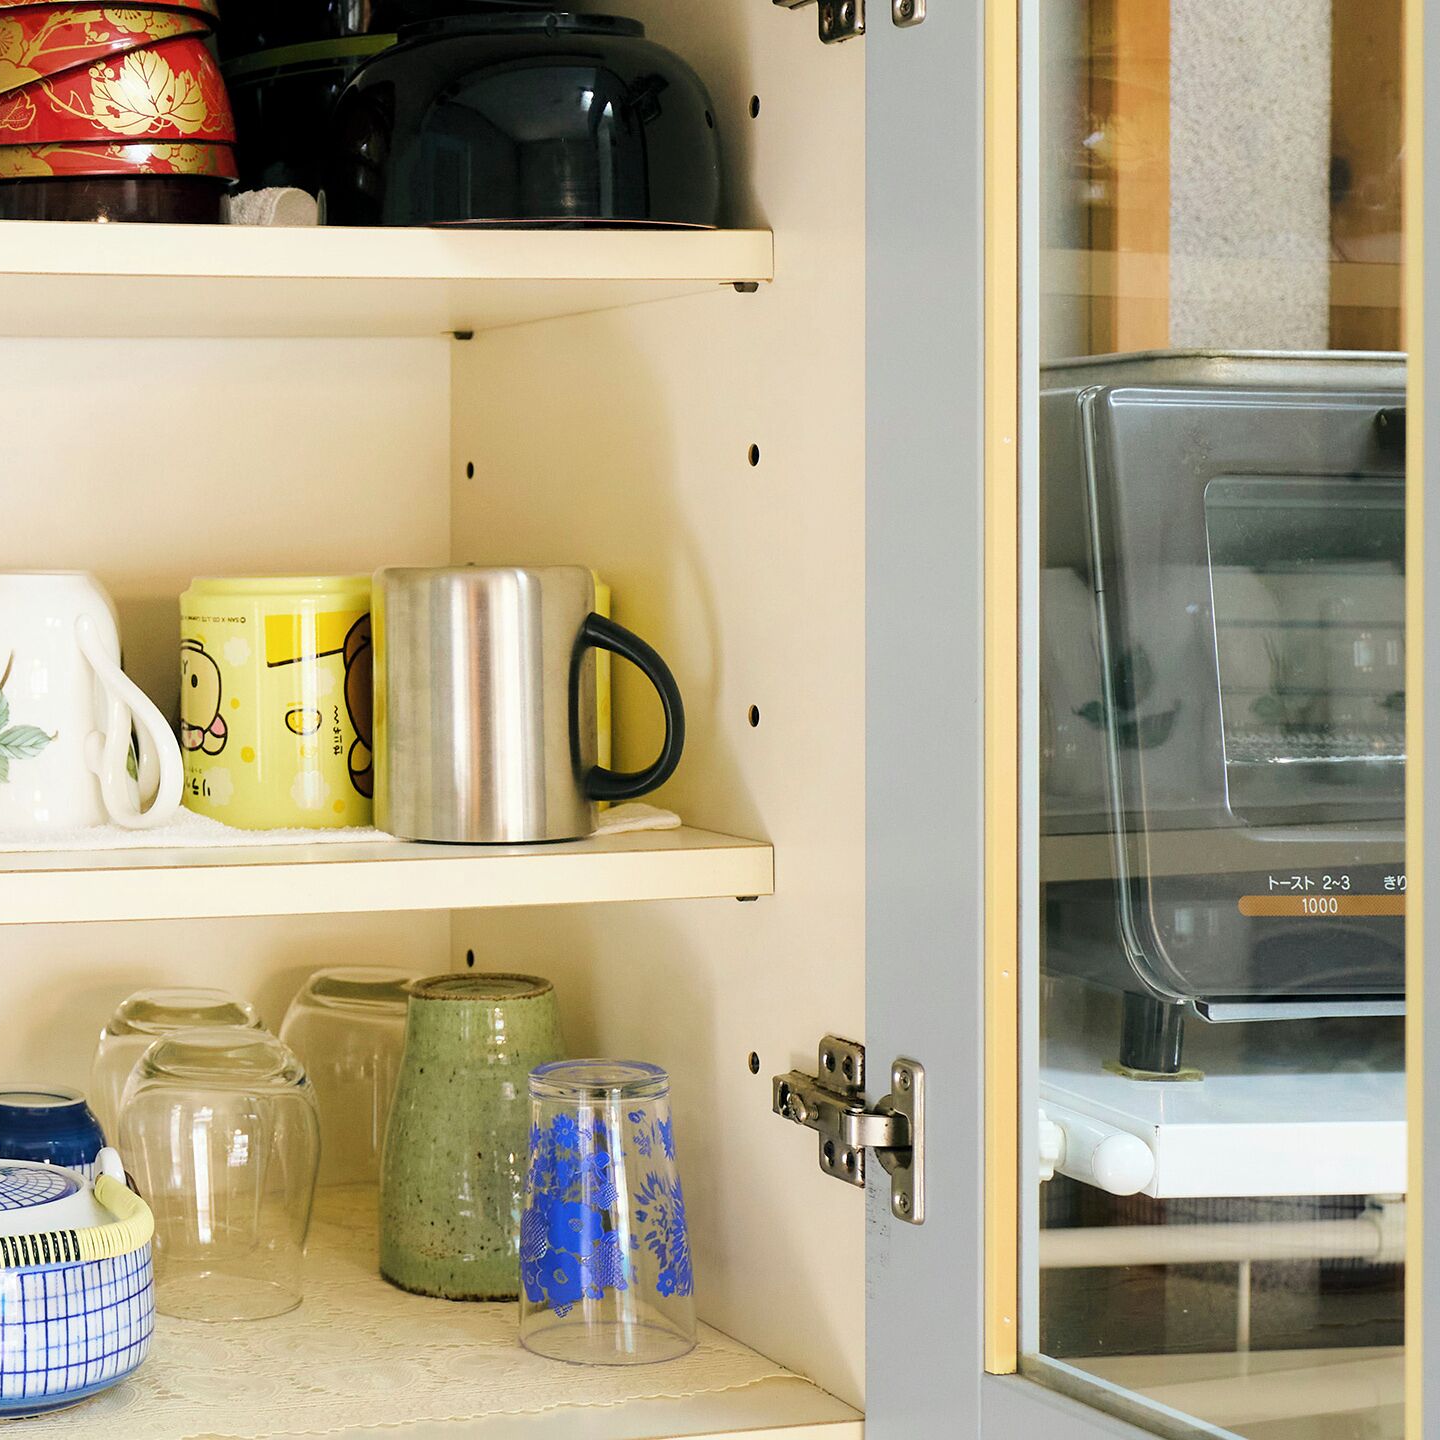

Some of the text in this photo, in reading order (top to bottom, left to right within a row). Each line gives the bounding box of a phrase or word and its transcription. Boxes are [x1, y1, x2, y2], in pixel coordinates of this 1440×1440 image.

[1268, 875, 1315, 891] トースト
[1302, 897, 1338, 914] 1000
